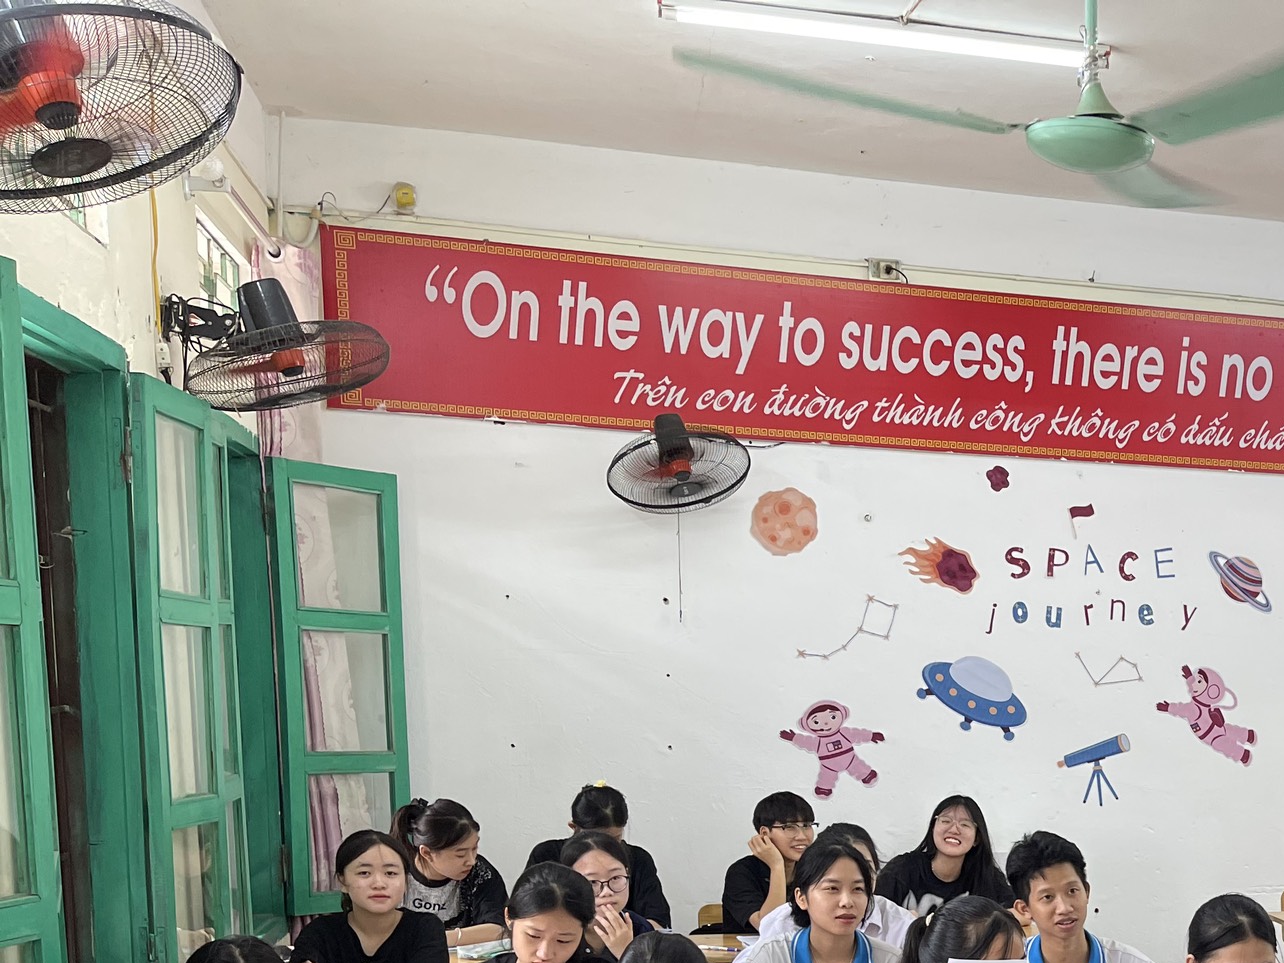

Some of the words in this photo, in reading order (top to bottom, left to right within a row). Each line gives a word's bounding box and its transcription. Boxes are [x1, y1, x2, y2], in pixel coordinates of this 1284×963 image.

[426, 266, 540, 342] “On
[558, 280, 641, 351] the
[659, 305, 765, 375] way
[779, 301, 825, 367] to
[839, 321, 1037, 393] success,
[1052, 326, 1165, 393] there
[1177, 337, 1208, 397] is
[1219, 354, 1273, 402] no
[613, 370, 689, 409] Trên
[696, 389, 757, 415] con
[764, 384, 869, 430] đường
[873, 394, 966, 430] thành
[970, 402, 1046, 443] công
[1048, 405, 1140, 449] không
[1143, 413, 1177, 443] có
[1181, 412, 1234, 447] dấu
[1004, 543, 1176, 582] SPACE
[985, 598, 1198, 635] journey
